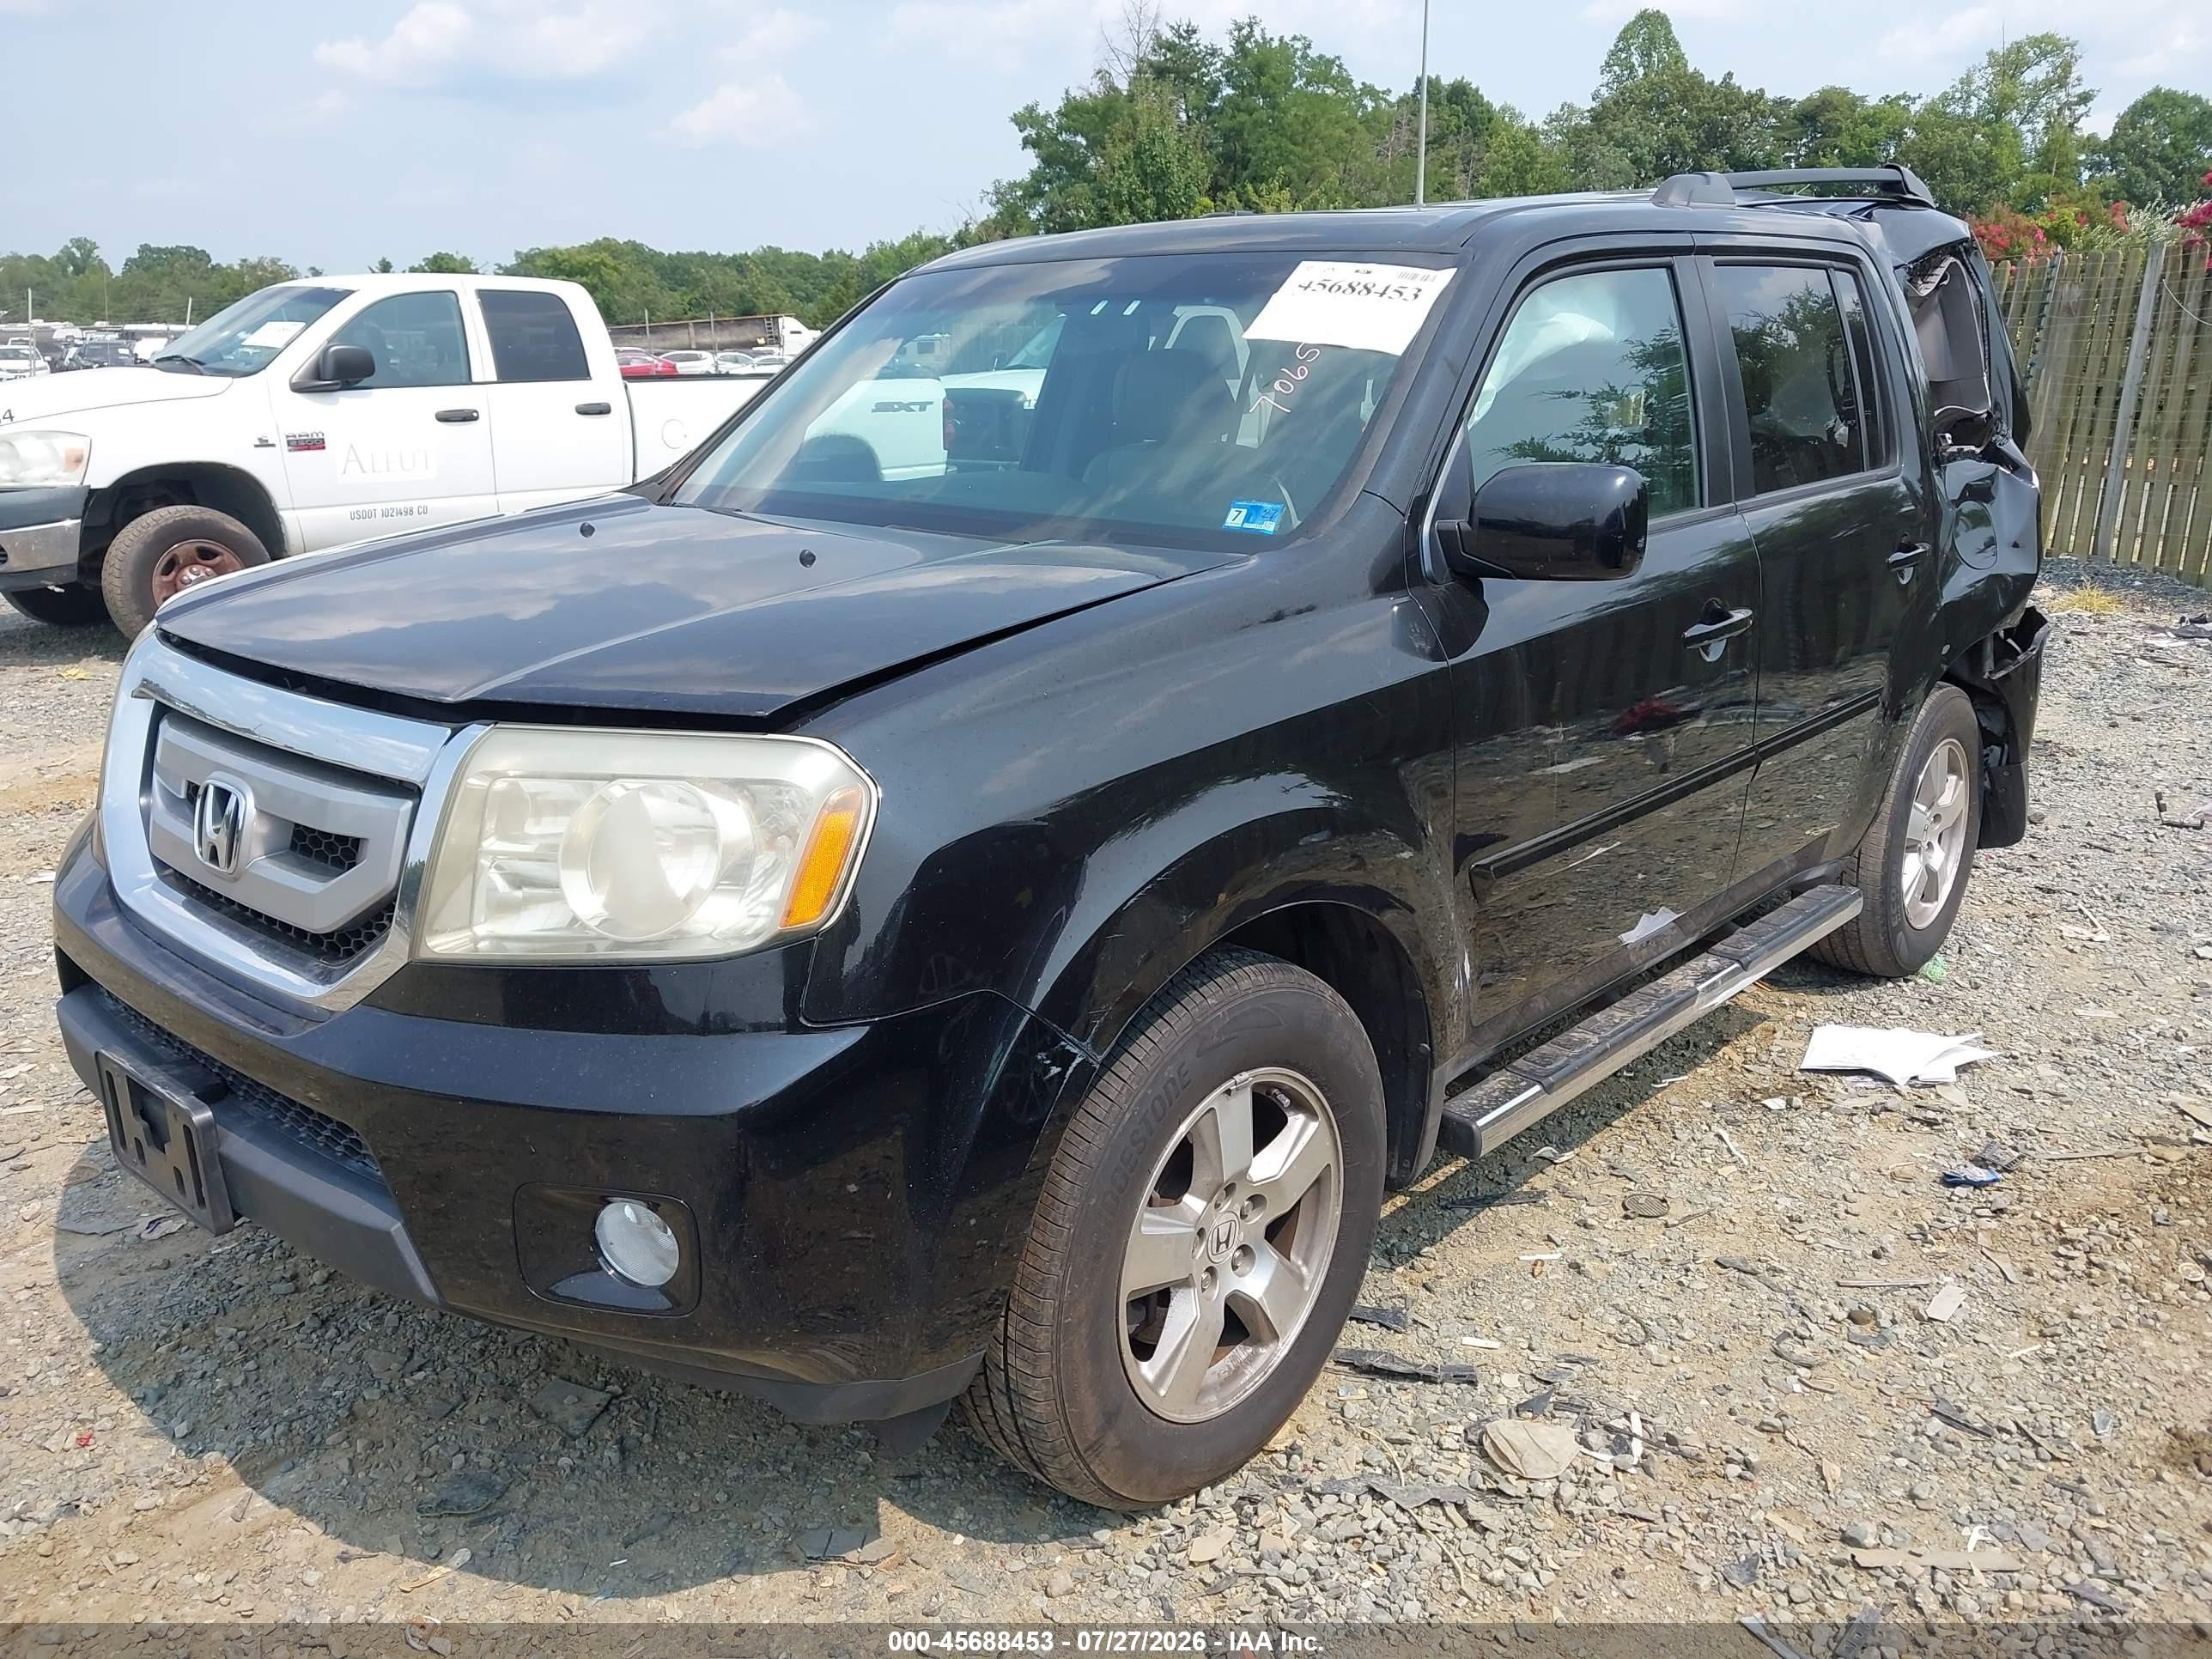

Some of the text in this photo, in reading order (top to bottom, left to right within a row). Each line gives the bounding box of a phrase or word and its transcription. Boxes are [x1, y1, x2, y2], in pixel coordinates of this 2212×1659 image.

[1298, 278, 1423, 301] 45688453
[871, 400, 934, 414] SXT
[0, 408, 15, 423] 4
[349, 508, 377, 522] USDOT
[380, 506, 414, 520] 1021498
[1231, 509, 1243, 523] 7
